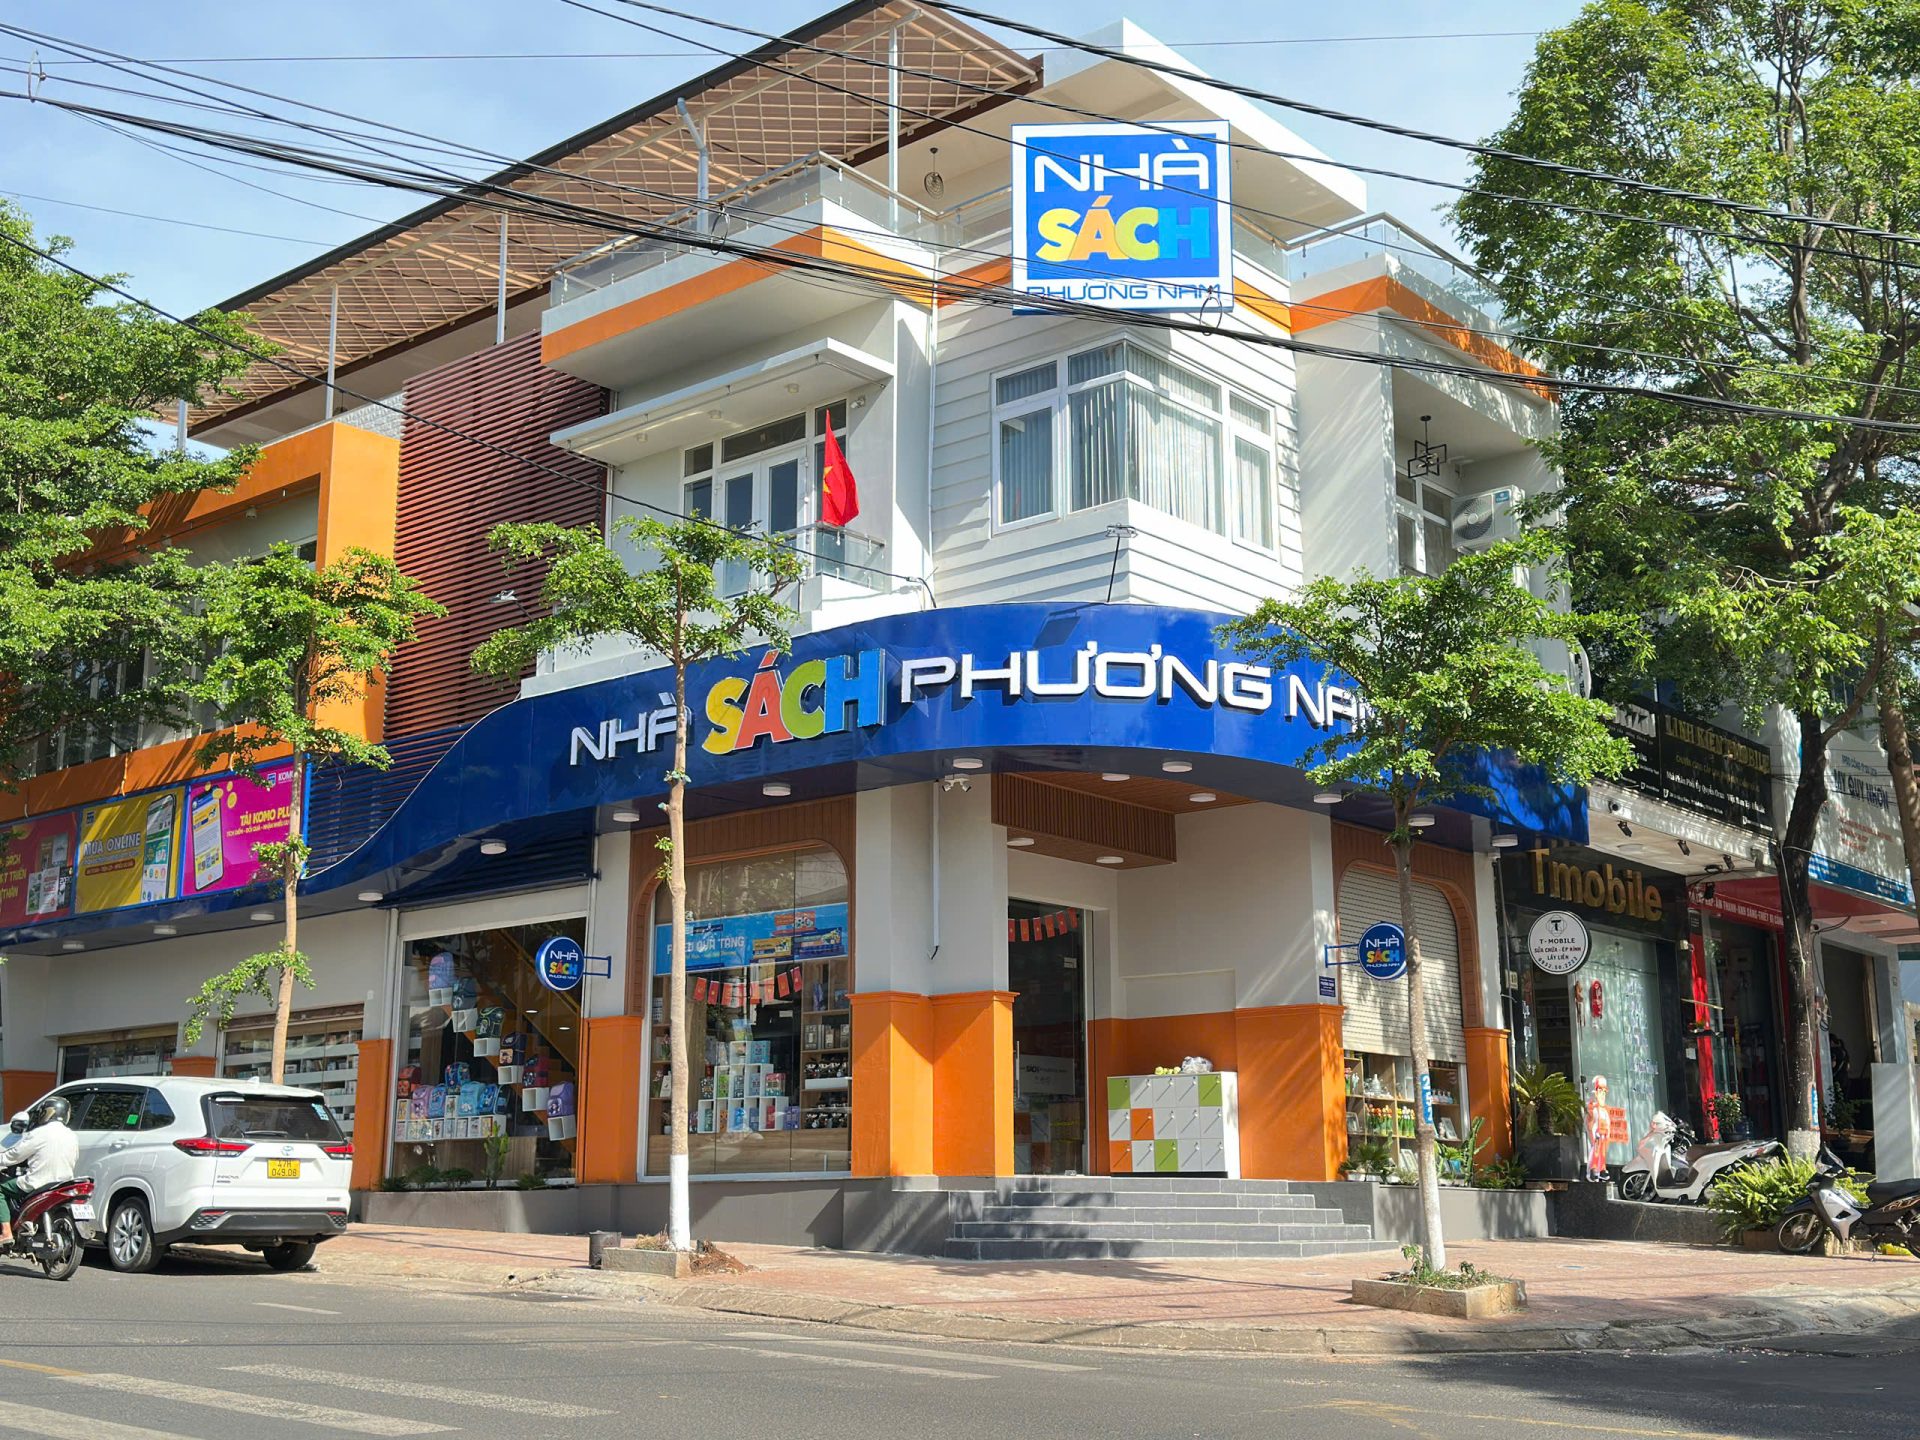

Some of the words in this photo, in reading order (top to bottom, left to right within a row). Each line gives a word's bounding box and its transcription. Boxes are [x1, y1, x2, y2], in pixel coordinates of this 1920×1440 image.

[1034, 139, 1209, 192] NHÀ
[1035, 195, 1211, 262] SÁCH
[1027, 283, 1149, 300] PHƯƠNG
[1158, 284, 1221, 299] NAM
[570, 691, 692, 765] NHÀ
[701, 649, 886, 755] SÁCH
[901, 641, 1273, 711] PHƯƠNG
[106, 832, 141, 852] ONLINE
[1551, 919, 1562, 931] T
[1366, 935, 1400, 948] NHÀ
[550, 949, 578, 962] NHÀ
[1366, 948, 1400, 963] SÁCH
[550, 960, 578, 975] SÁCH
